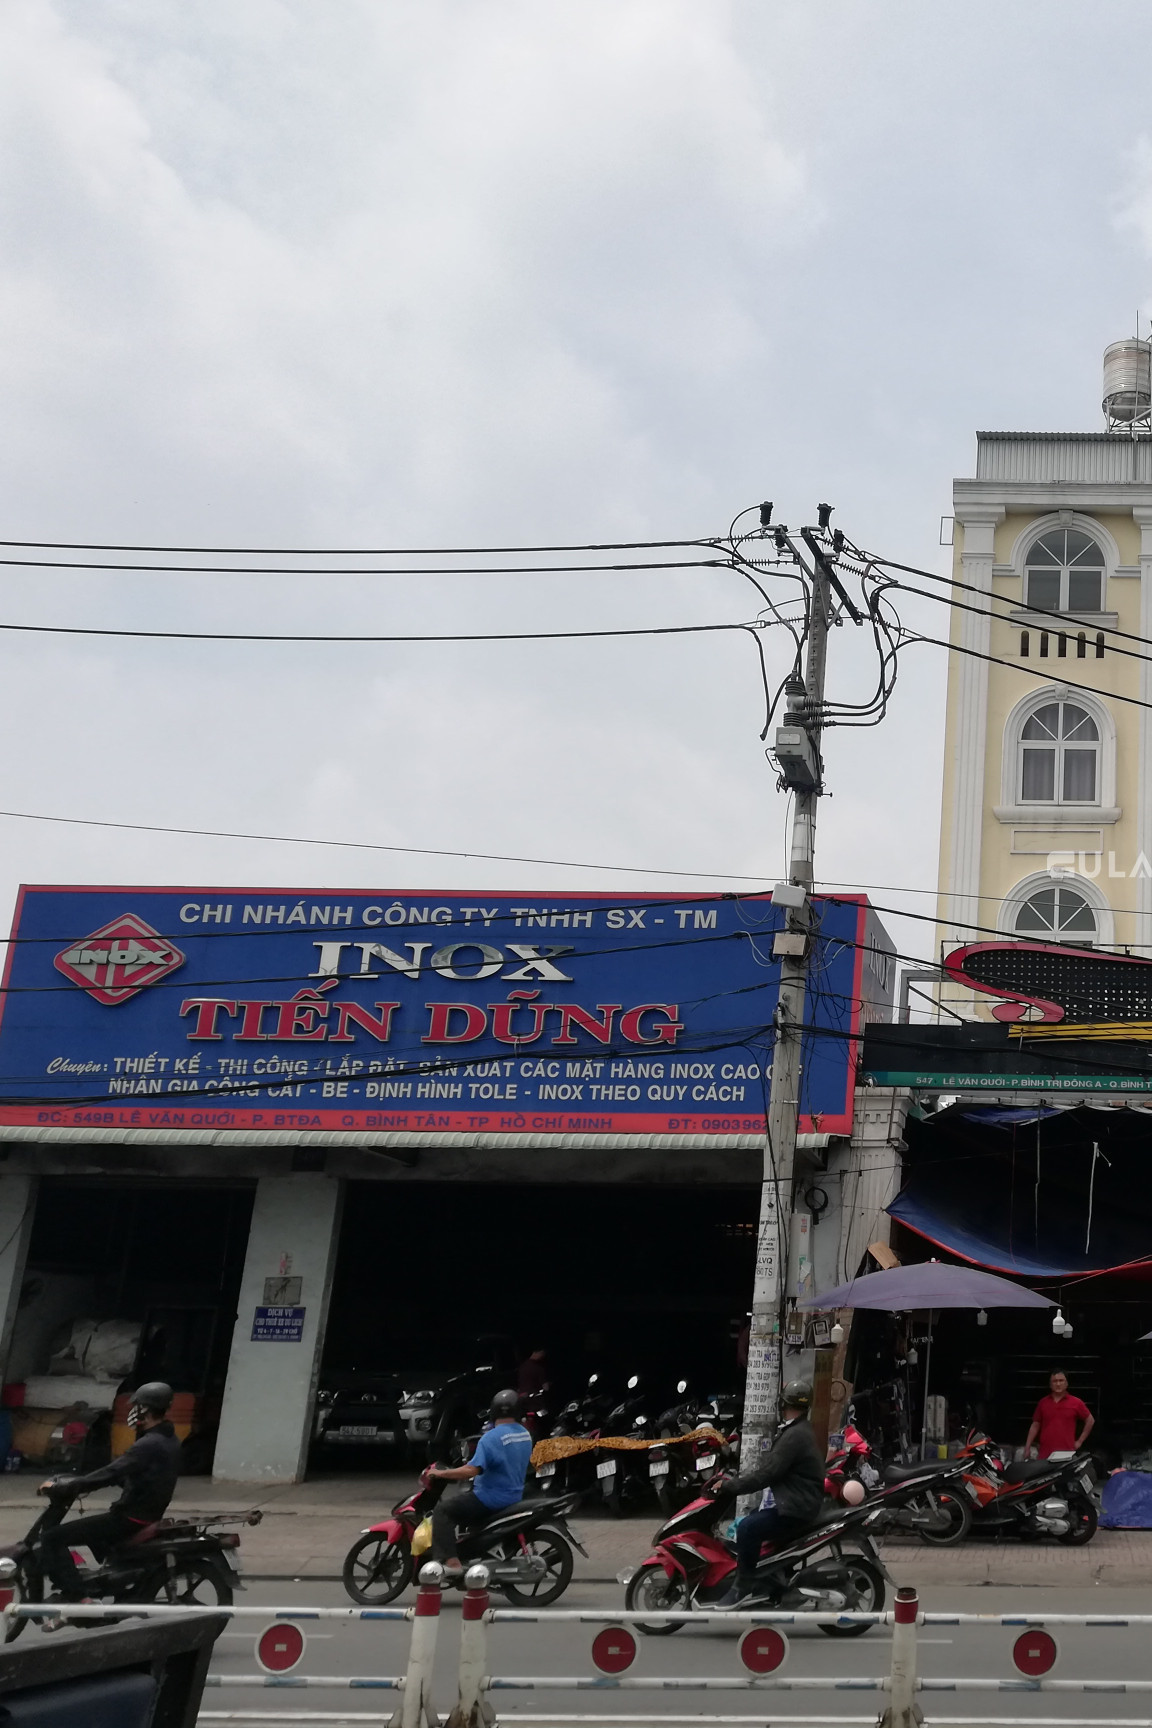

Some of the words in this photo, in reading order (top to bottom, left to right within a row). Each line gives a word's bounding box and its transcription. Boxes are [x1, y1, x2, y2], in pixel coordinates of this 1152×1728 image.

[179, 903, 232, 923] CHI
[242, 901, 352, 925] NHÁNH
[362, 902, 452, 926] CÔNG
[460, 908, 498, 926] TY
[511, 908, 592, 928] TNHH
[606, 910, 647, 928] SX
[674, 910, 717, 928] TM
[68, 949, 172, 965] INOX
[308, 941, 575, 981] INOX
[179, 979, 401, 1042] TIẾN
[421, 990, 684, 1045] DŨNG
[114, 1052, 170, 1073] THIẾT
[174, 1052, 201, 1073] KẾ
[218, 1059, 247, 1074] THI
[253, 1055, 308, 1076] CÔNG
[520, 1059, 560, 1078] CÁC
[566, 1059, 604, 1081] MẶT
[611, 1059, 664, 1079] HÀNG
[671, 1064, 715, 1079] INOX
[721, 1064, 760, 1080] CAO
[168, 1080, 199, 1093] GIA
[366, 1082, 412, 1101] ĐỊNH
[417, 1080, 463, 1098] HÌNH
[469, 1084, 518, 1099] TOLE
[539, 1085, 583, 1100] INOX
[589, 1085, 641, 1101] THEO
[647, 1086, 687, 1101] QUY
[692, 1082, 745, 1101] CÁCH
[119, 1112, 142, 1123] LÊ
[149, 1111, 184, 1124] VĂN
[366, 1113, 408, 1127] BÌNH
[415, 1114, 450, 1127] TÂN
[501, 1112, 526, 1127] HỒ
[532, 1115, 564, 1128] CHÍ
[568, 1118, 612, 1129] MINH
